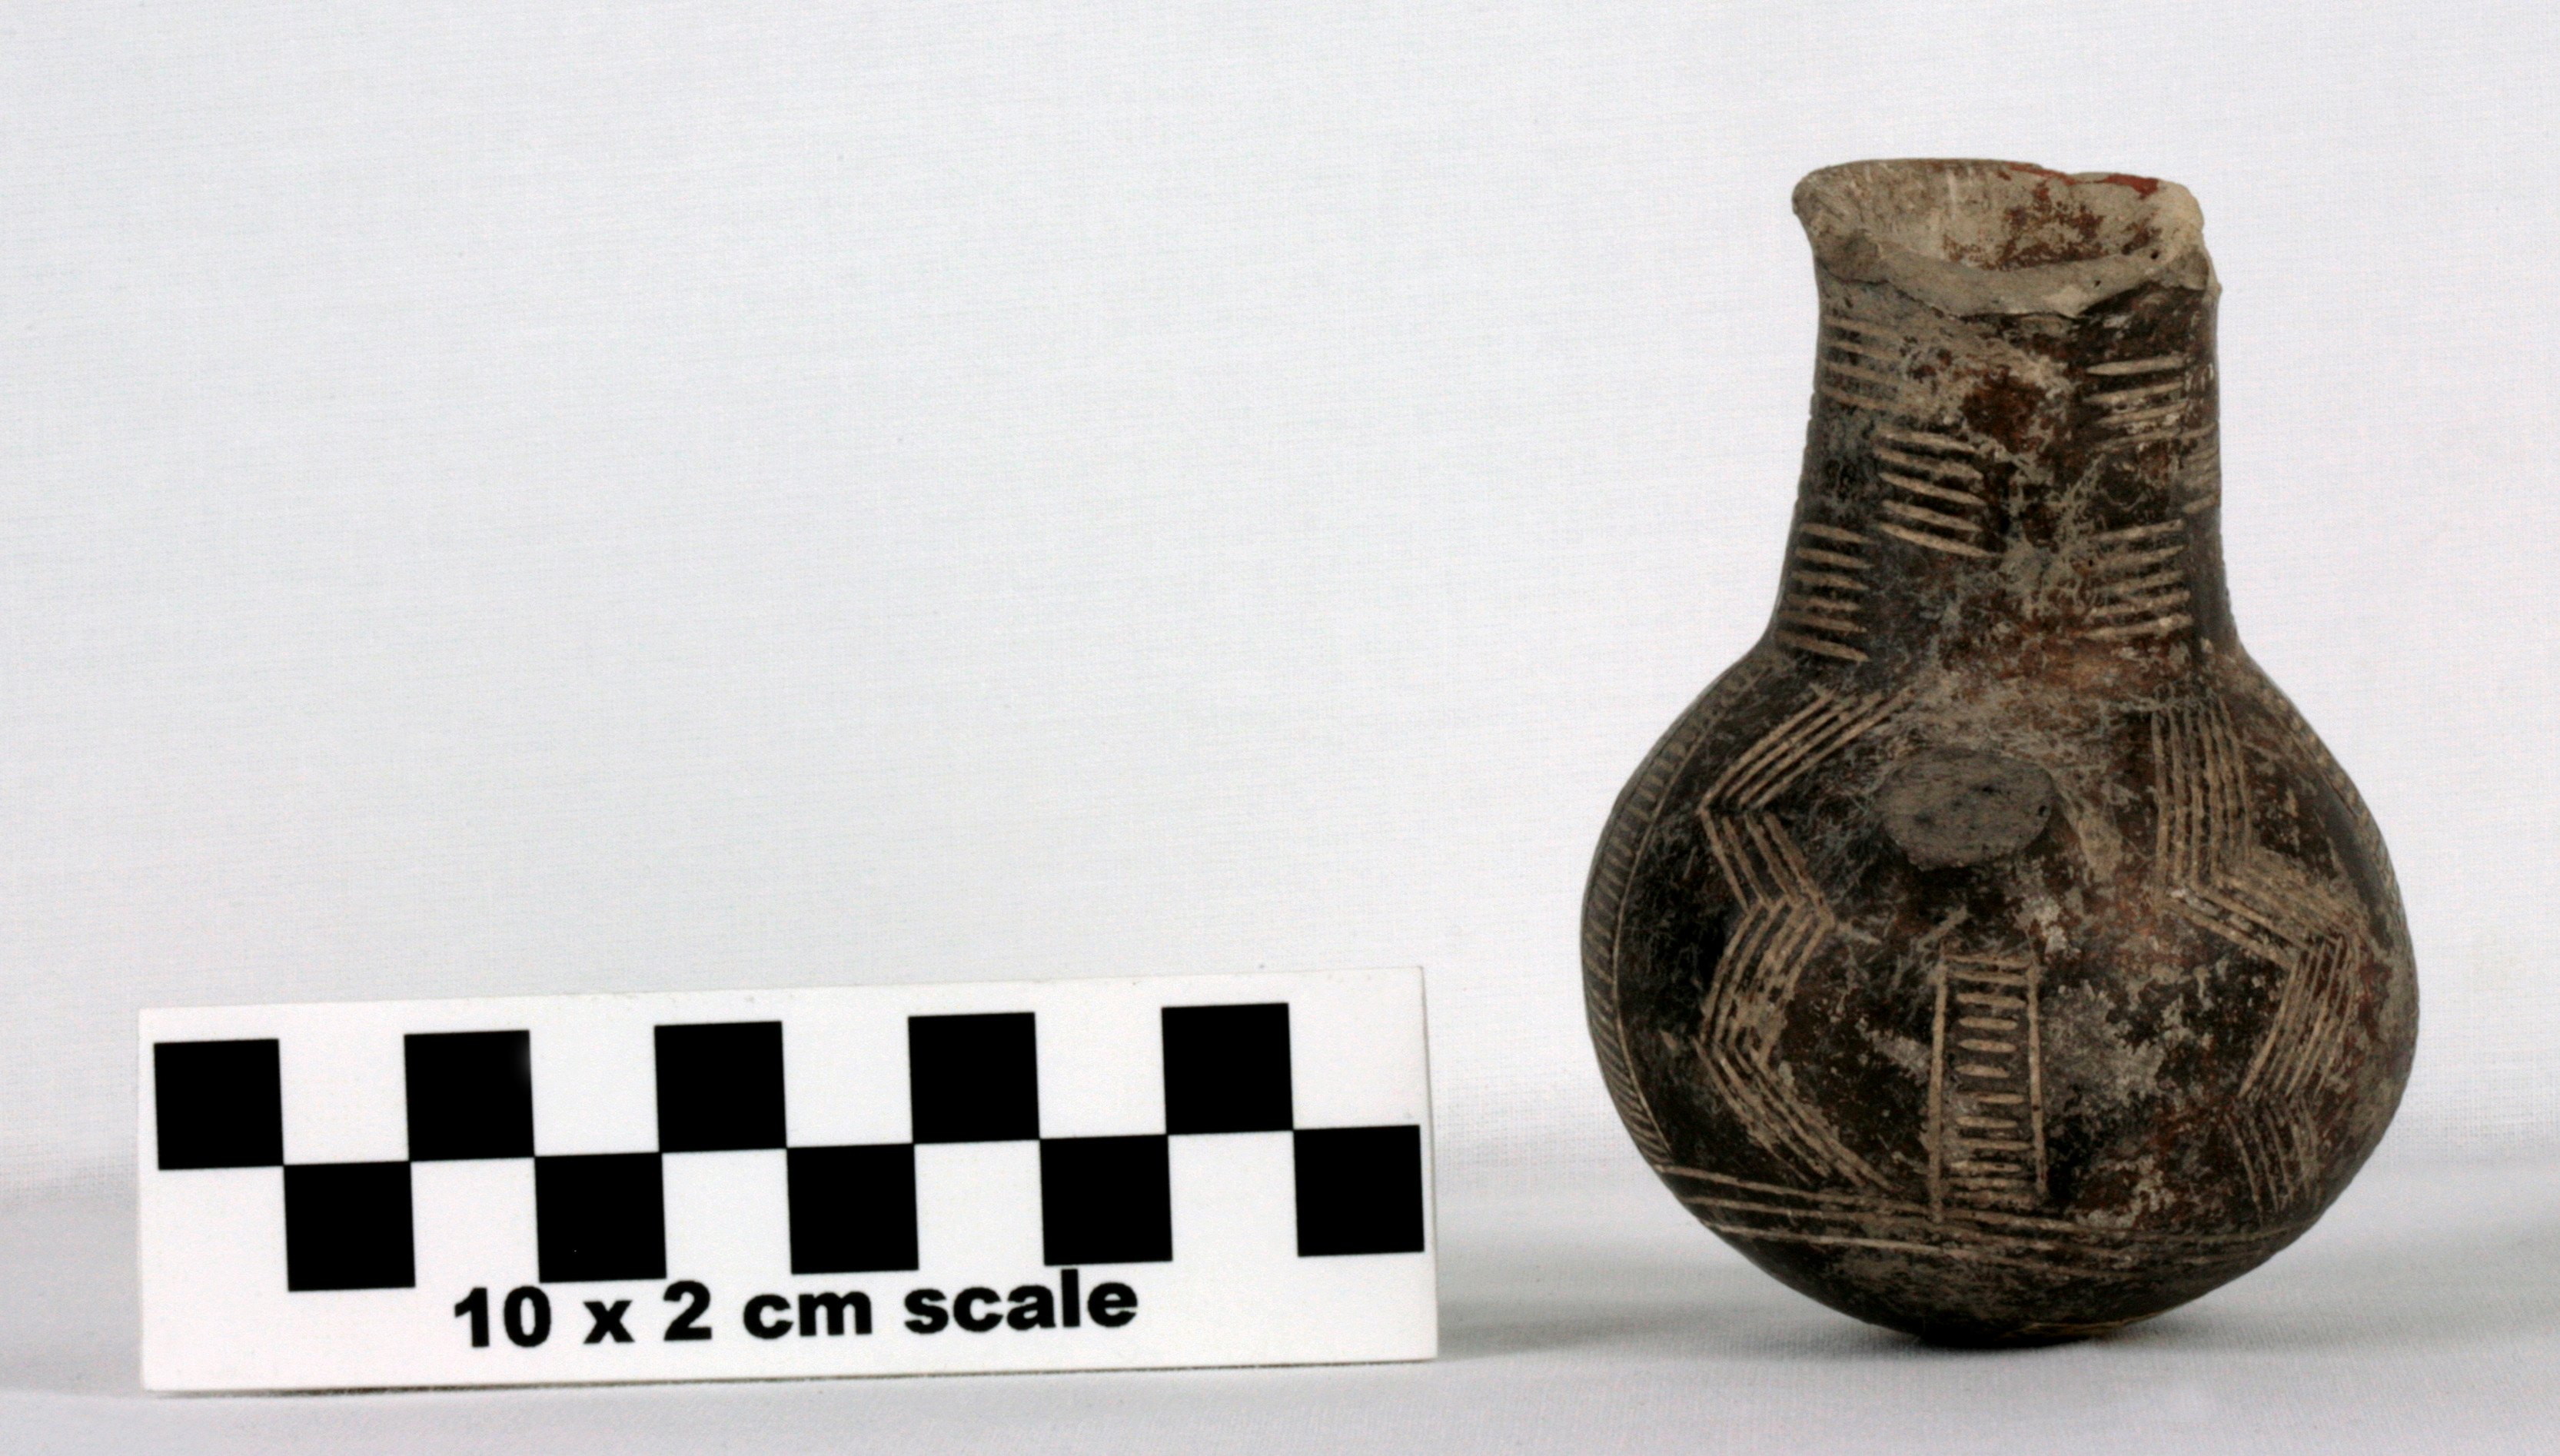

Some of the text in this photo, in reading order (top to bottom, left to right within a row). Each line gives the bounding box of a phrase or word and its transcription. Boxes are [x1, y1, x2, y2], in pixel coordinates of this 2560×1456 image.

[454, 1268, 1139, 1348] 10 x 2 cm scale
